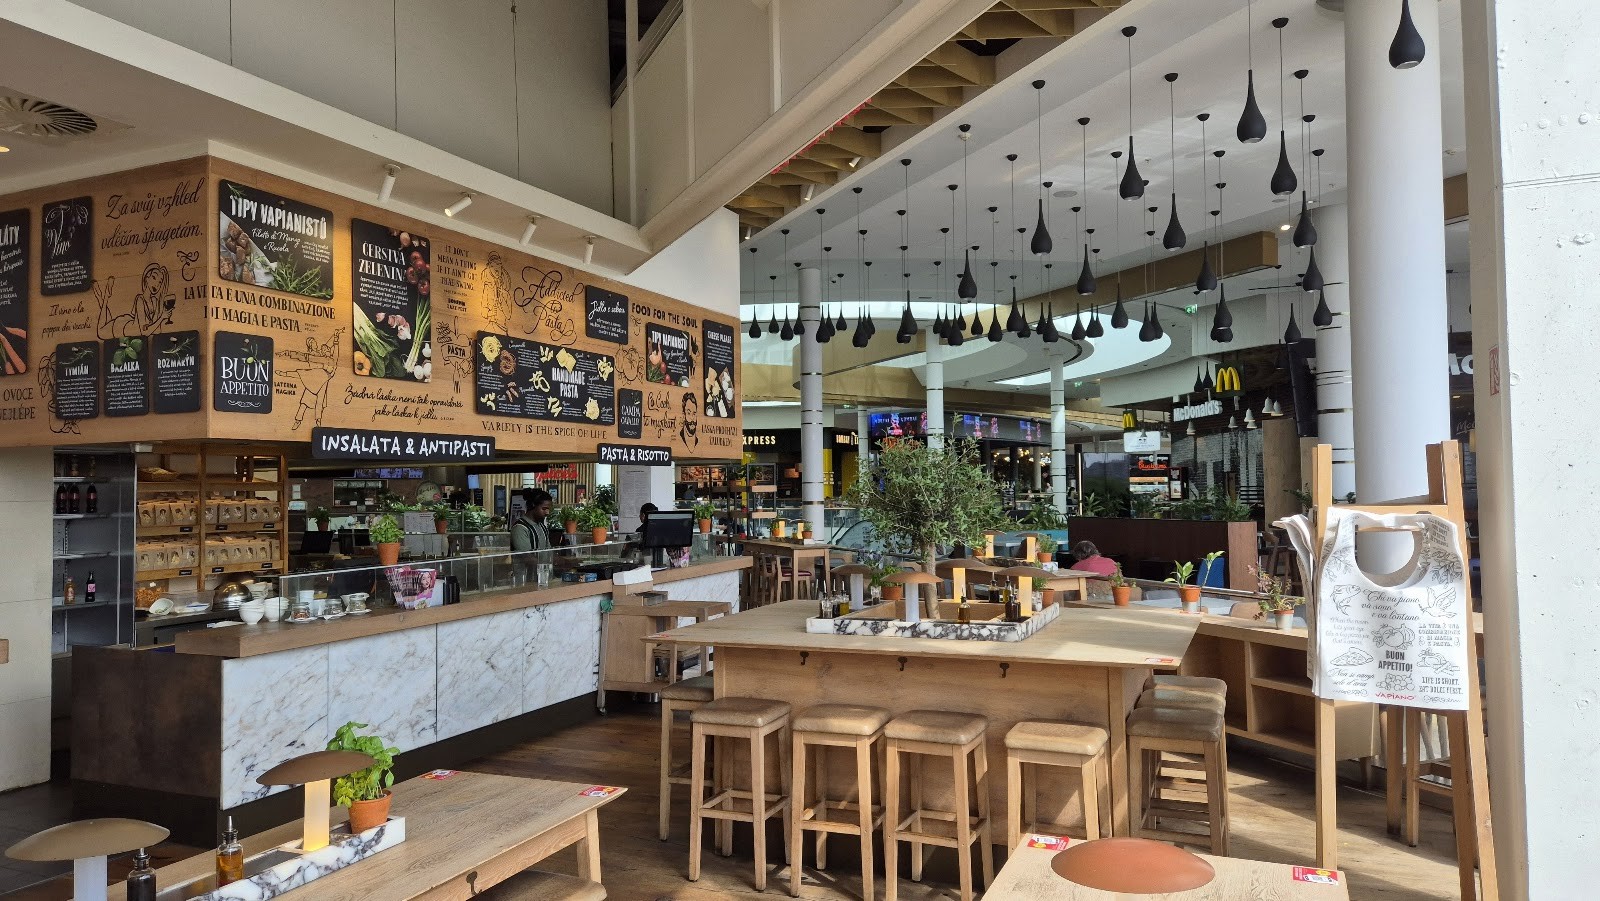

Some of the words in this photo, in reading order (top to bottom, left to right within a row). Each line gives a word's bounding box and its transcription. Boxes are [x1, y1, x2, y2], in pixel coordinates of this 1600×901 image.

[230, 194, 258, 222] TIPY
[261, 203, 327, 240] VAPIANISTŮ
[362, 241, 406, 267] ČERSTVÁ
[184, 286, 195, 300] LA
[235, 289, 257, 306] UNA
[259, 294, 336, 320] COMBINAZIONE
[222, 307, 259, 327] MAGIA
[260, 314, 268, 328] E
[631, 303, 651, 317] FOOD
[653, 309, 667, 321] FOR
[668, 312, 681, 325] THE
[682, 316, 699, 329] SOUL
[448, 346, 466, 358] PASTA
[221, 356, 271, 382] BUON
[3, 387, 33, 402] OVOCE
[220, 381, 270, 397] APPETITO
[560, 383, 579, 399] PASTA
[1174, 399, 1223, 422] McDonald's
[482, 420, 523, 433] VARIETY
[525, 424, 533, 434] IS
[535, 425, 553, 436] THE
[555, 427, 575, 437] SPICE
[578, 428, 588, 438] OF
[590, 430, 608, 440] LIFE
[322, 434, 401, 456] INSALATA
[406, 437, 415, 455] &
[419, 437, 490, 458] ANTIPASTI
[742, 435, 776, 446] XPRESS
[601, 447, 629, 462] PASTA
[630, 449, 636, 461] &
[637, 448, 669, 462] RISOTTO
[1385, 650, 1405, 661] BUON
[1378, 660, 1413, 673] APPETITO!
[1375, 692, 1415, 701] VAPIANO
